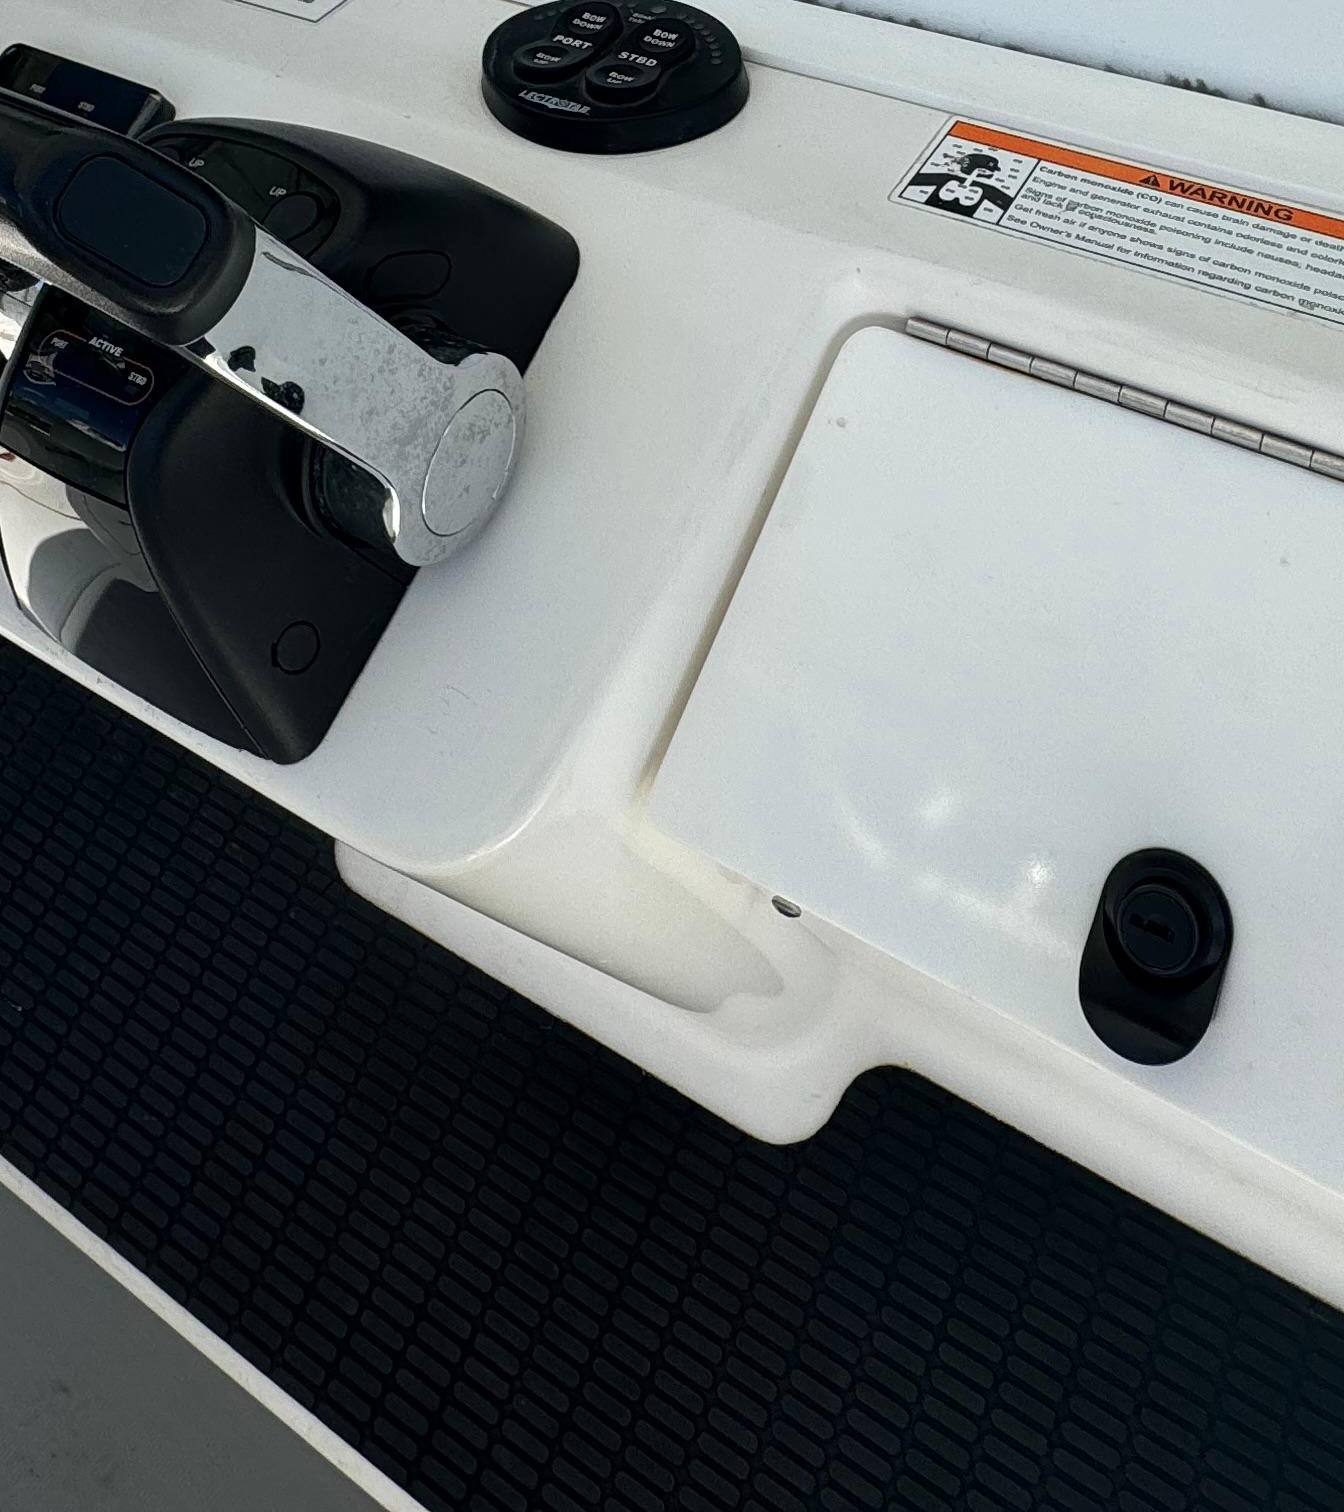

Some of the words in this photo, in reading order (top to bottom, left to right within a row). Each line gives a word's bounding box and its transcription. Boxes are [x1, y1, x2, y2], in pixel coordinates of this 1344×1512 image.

[572, 18, 604, 31] DOWN
[582, 11, 607, 23] BOW
[552, 34, 593, 51] PORT
[643, 35, 675, 49] DOWN
[653, 28, 680, 41] BOW
[617, 50, 658, 68] STBD
[188, 156, 205, 168] UP
[269, 186, 287, 197] UP
[1020, 192, 1040, 203] and
[1042, 198, 1063, 209] lack
[1038, 165, 1078, 181] Carbon
[1080, 176, 1134, 196] monoxide
[1135, 190, 1162, 205] (CO)
[1164, 199, 1183, 209] can
[1186, 205, 1219, 219] cause
[1221, 214, 1249, 227] brain
[1250, 221, 1297, 240] damage
[1300, 235, 1310, 243] or
[1169, 182, 1294, 222] WARNING
[1031, 175, 1068, 192] Engine
[1069, 186, 1089, 196] and
[1090, 192, 1139, 211] generator
[1142, 206, 1185, 223] exhaust
[1286, 244, 1308, 256] and
[1023, 186, 1054, 201] Signs
[1055, 195, 1066, 203] of
[1105, 208, 1157, 228] monoxide
[1158, 224, 1211, 244] poisoning
[1214, 238, 1254, 255] include
[1256, 251, 1302, 269] nausea,
[1013, 203, 1033, 214] Get
[1034, 208, 1061, 222] fresh
[1062, 217, 1076, 226] air
[1086, 224, 1126, 241] anyone
[1129, 235, 1164, 251] shows
[1166, 245, 1199, 261] signs
[1198, 254, 1210, 263] of
[1212, 258, 1251, 275] carbon
[1254, 270, 1310, 291] monoxide
[1006, 214, 1028, 225] See
[1029, 220, 1073, 238] Owner's
[1074, 233, 1115, 250] Manual
[1116, 245, 1131, 255] for
[1133, 249, 1195, 273] information
[1197, 268, 1252, 290] regarding
[1254, 284, 1295, 301] carbon
[87, 336, 124, 357] ACTIVE
